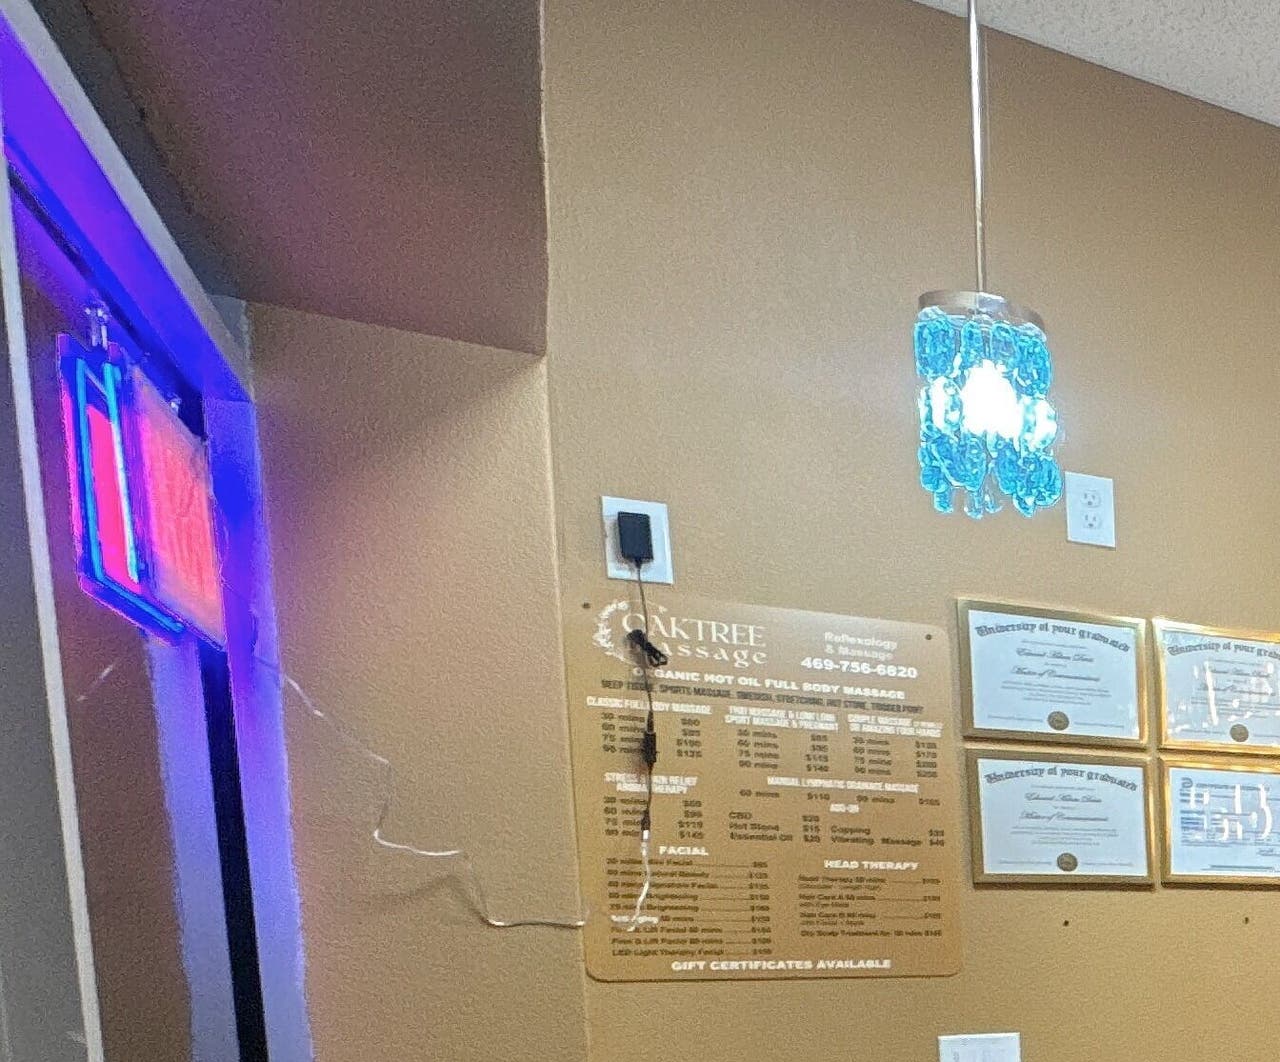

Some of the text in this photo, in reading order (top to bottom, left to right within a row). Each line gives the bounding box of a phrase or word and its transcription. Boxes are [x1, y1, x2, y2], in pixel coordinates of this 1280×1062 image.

[622, 613, 767, 647] OAKTREE
[824, 631, 898, 651] Reflexology
[640, 641, 767, 669] assage
[632, 666, 906, 700] OGANIC HOT OIL FULL BODY MASSAGE
[659, 846, 709, 856] FACIAL
[824, 859, 920, 871] HEAD THERAPY
[671, 959, 892, 972] GIFT CERTIFICATES AVAILABLE
